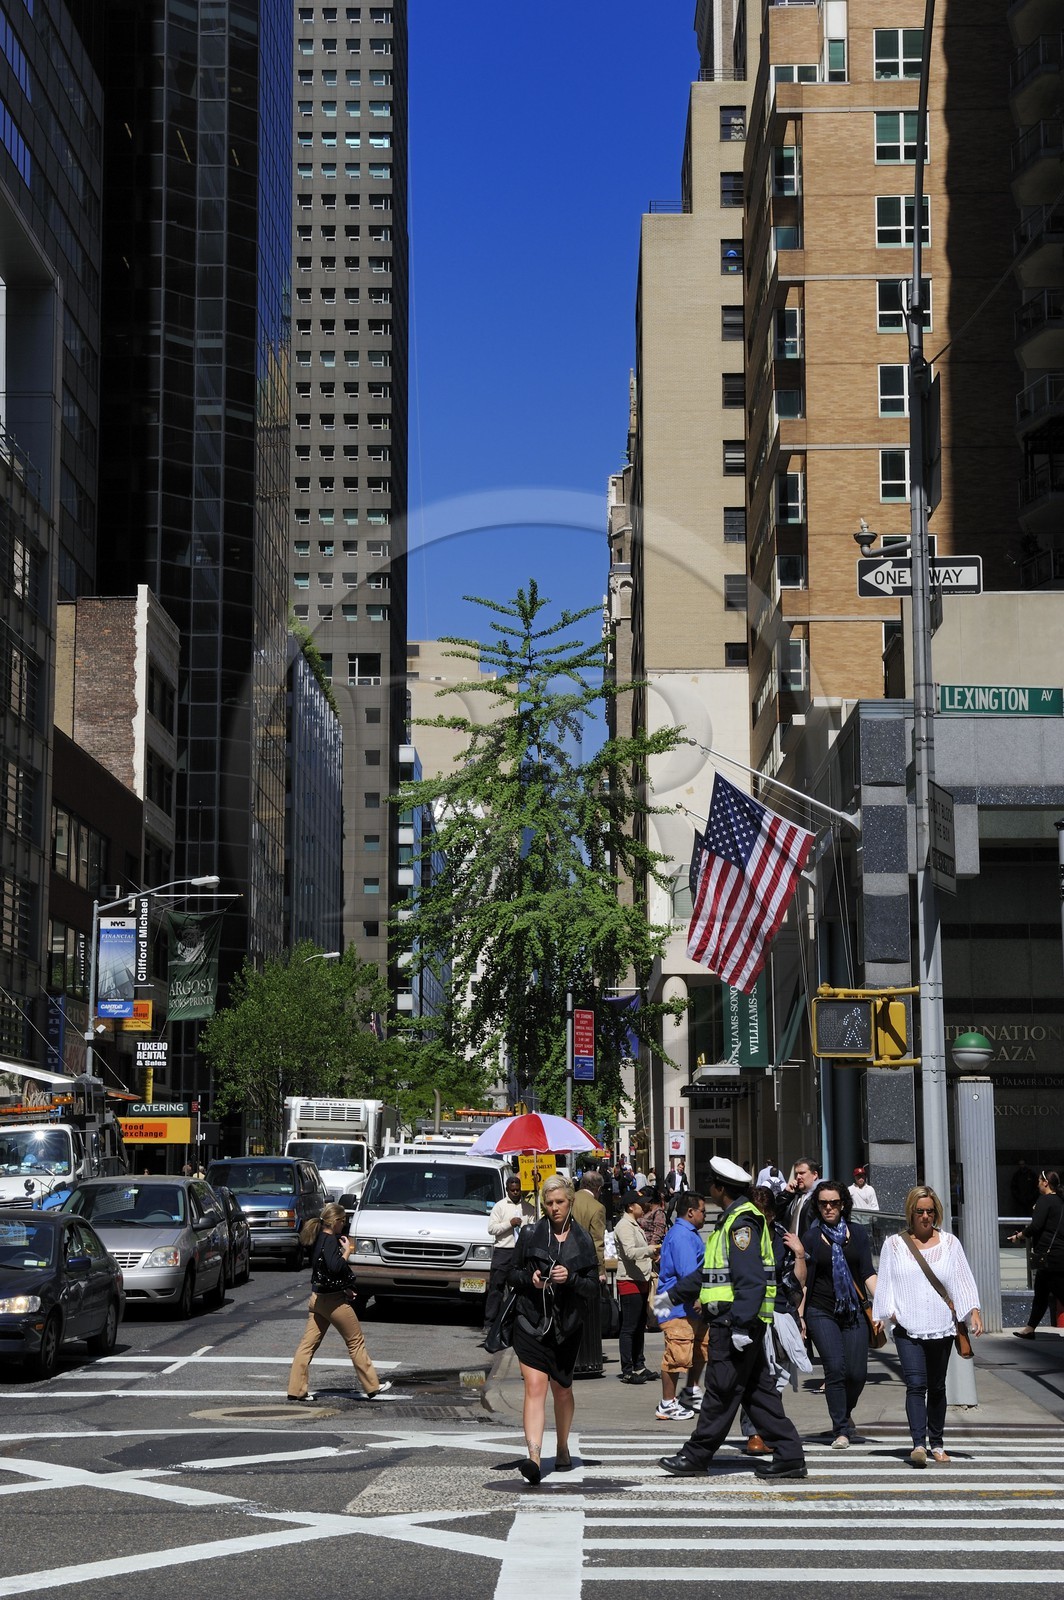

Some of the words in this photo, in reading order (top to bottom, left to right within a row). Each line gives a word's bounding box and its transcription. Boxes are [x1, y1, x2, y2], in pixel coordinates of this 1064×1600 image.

[874, 570, 907, 585] ONE
[928, 569, 963, 584] WAY
[944, 686, 1030, 712] LEXINGTON
[1040, 690, 1054, 702] AV
[138, 898, 148, 938] Michael
[137, 941, 147, 982] Clifford
[169, 978, 214, 996] ARGOSY
[189, 995, 214, 1006] PRINTS
[66, 1006, 86, 1024] ens
[748, 982, 760, 1055] WILLIAMS-S
[917, 1025, 1064, 1042] ITENATION
[136, 1042, 168, 1051] TUXEDO
[989, 1046, 1038, 1062] AZA
[136, 1051, 167, 1060] RENTAL
[1002, 1076, 1036, 1086] PALMER
[132, 1103, 184, 1112] CATERING
[994, 1105, 1060, 1116] XINGTON
[708, 1274, 727, 1283] PD
